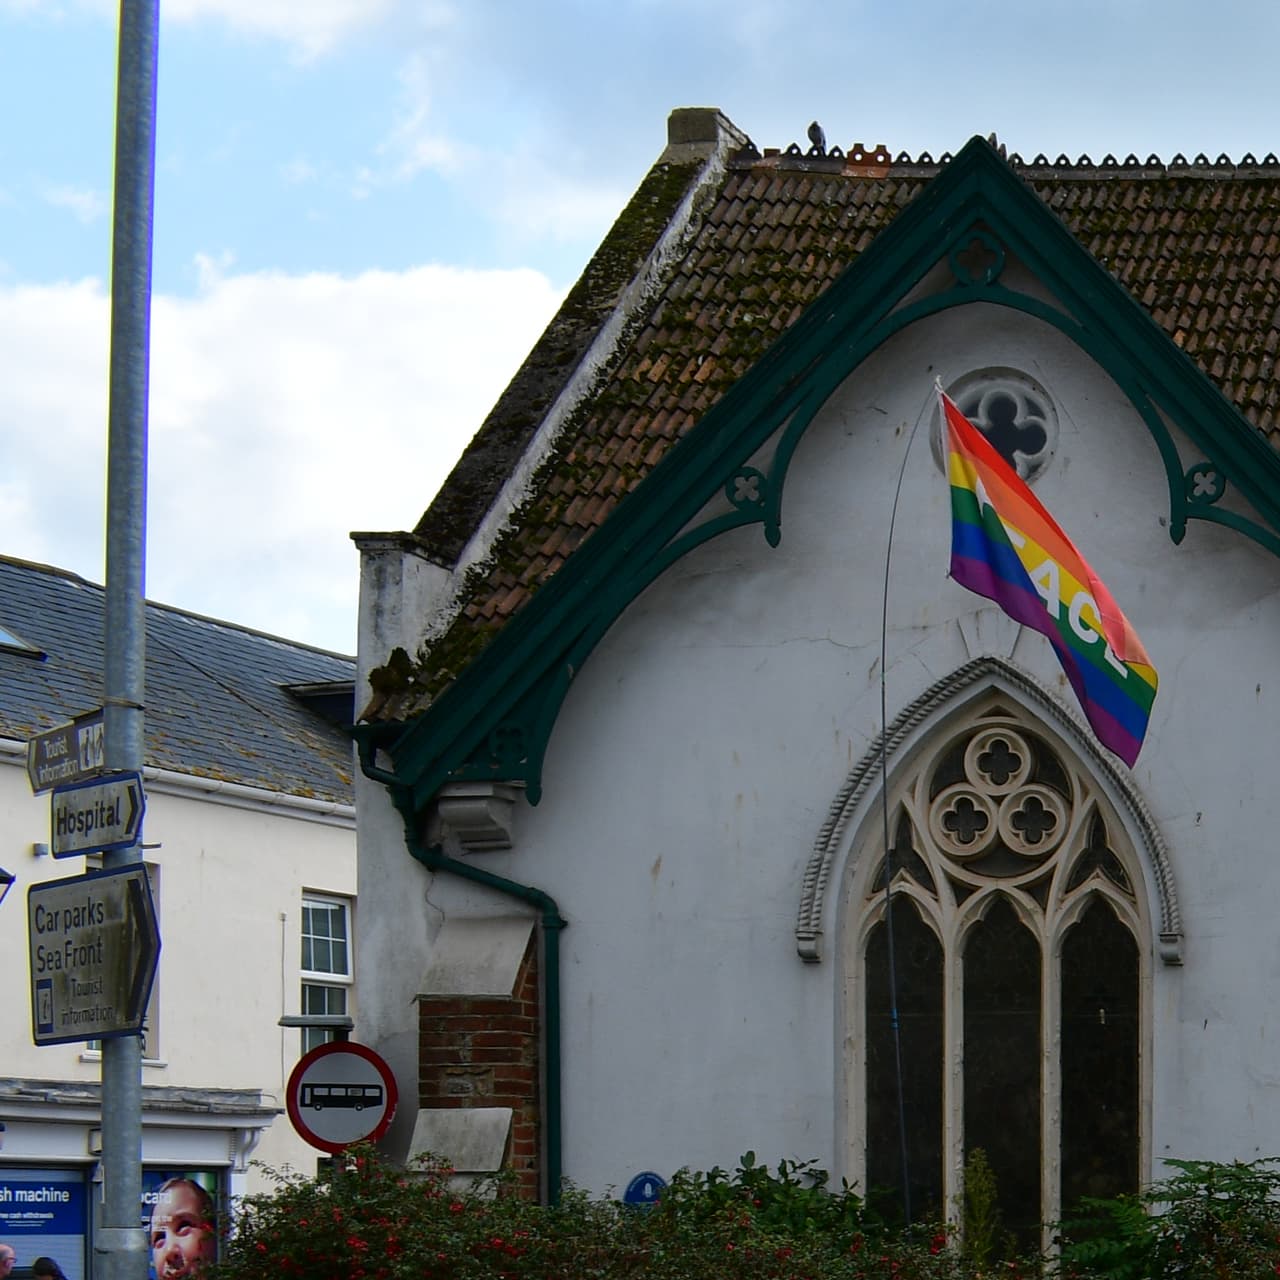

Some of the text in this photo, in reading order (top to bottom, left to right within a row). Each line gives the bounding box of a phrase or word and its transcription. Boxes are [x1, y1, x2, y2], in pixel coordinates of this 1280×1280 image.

[43, 735, 69, 760] Tourist
[40, 759, 79, 783] information
[56, 796, 121, 837] Hospital
[35, 896, 104, 935] Car parks
[37, 935, 103, 974] Sea Front
[71, 975, 103, 997] Tourist
[61, 1004, 113, 1026] information
[15, 1186, 71, 1203] machine
